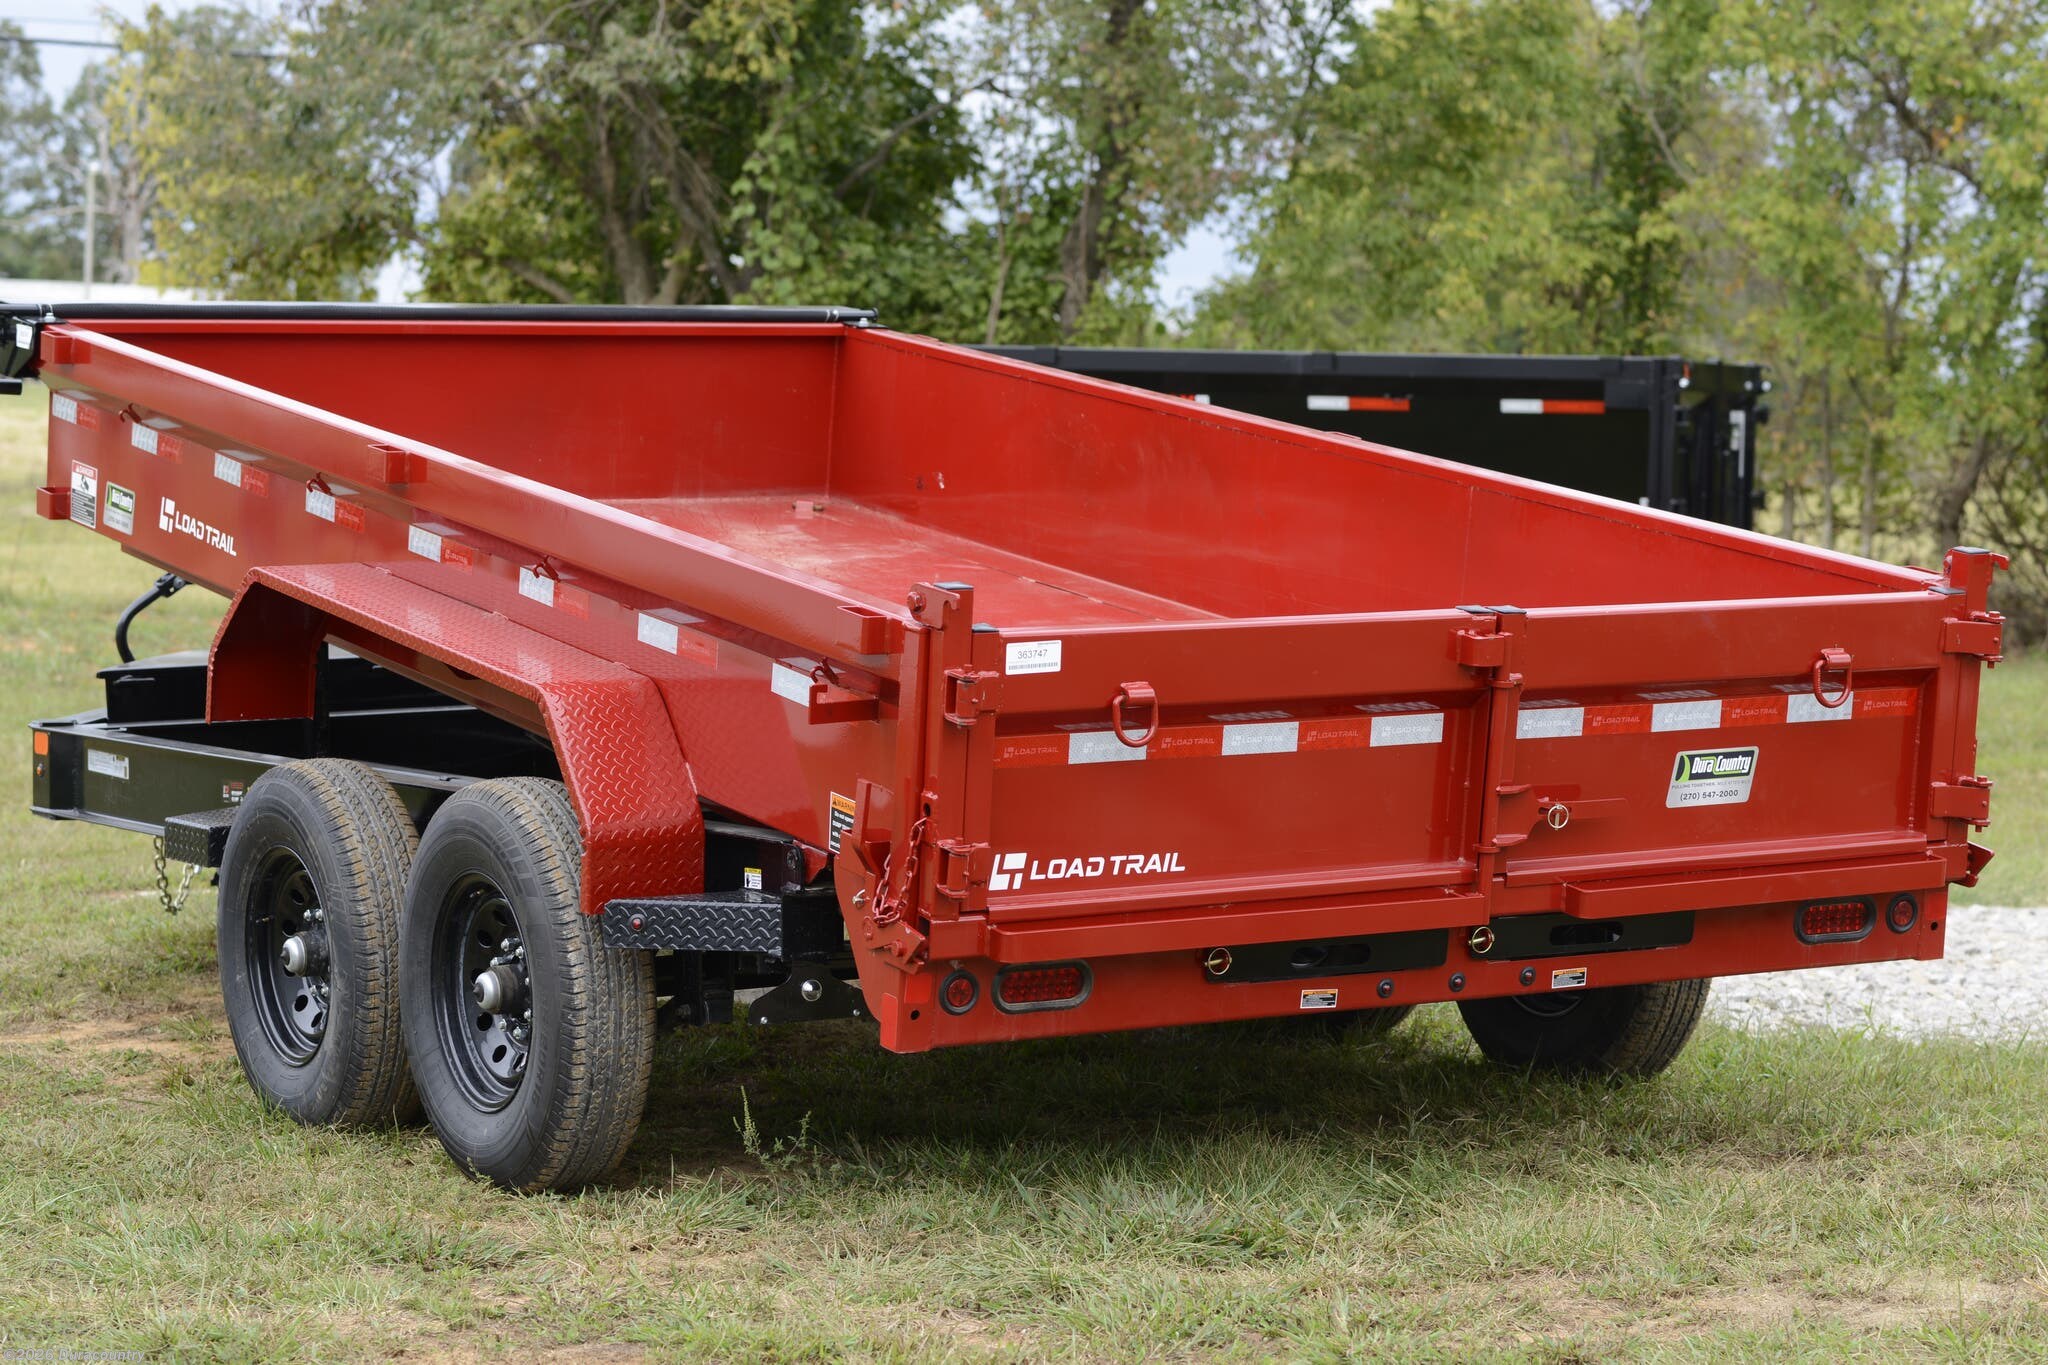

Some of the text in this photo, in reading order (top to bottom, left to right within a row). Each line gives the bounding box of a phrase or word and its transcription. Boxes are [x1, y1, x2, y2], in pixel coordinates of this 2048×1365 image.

[174, 510, 205, 541] LOAD
[205, 525, 238, 557] TRAIL
[1037, 746, 1060, 754] TRAIL
[1171, 738, 1193, 746] LOAD
[1691, 755, 1752, 774] Dura Country
[1680, 789, 1739, 802] (270) 547-2000
[1029, 856, 1105, 880] LOAD
[1110, 852, 1186, 876] TRAIL
